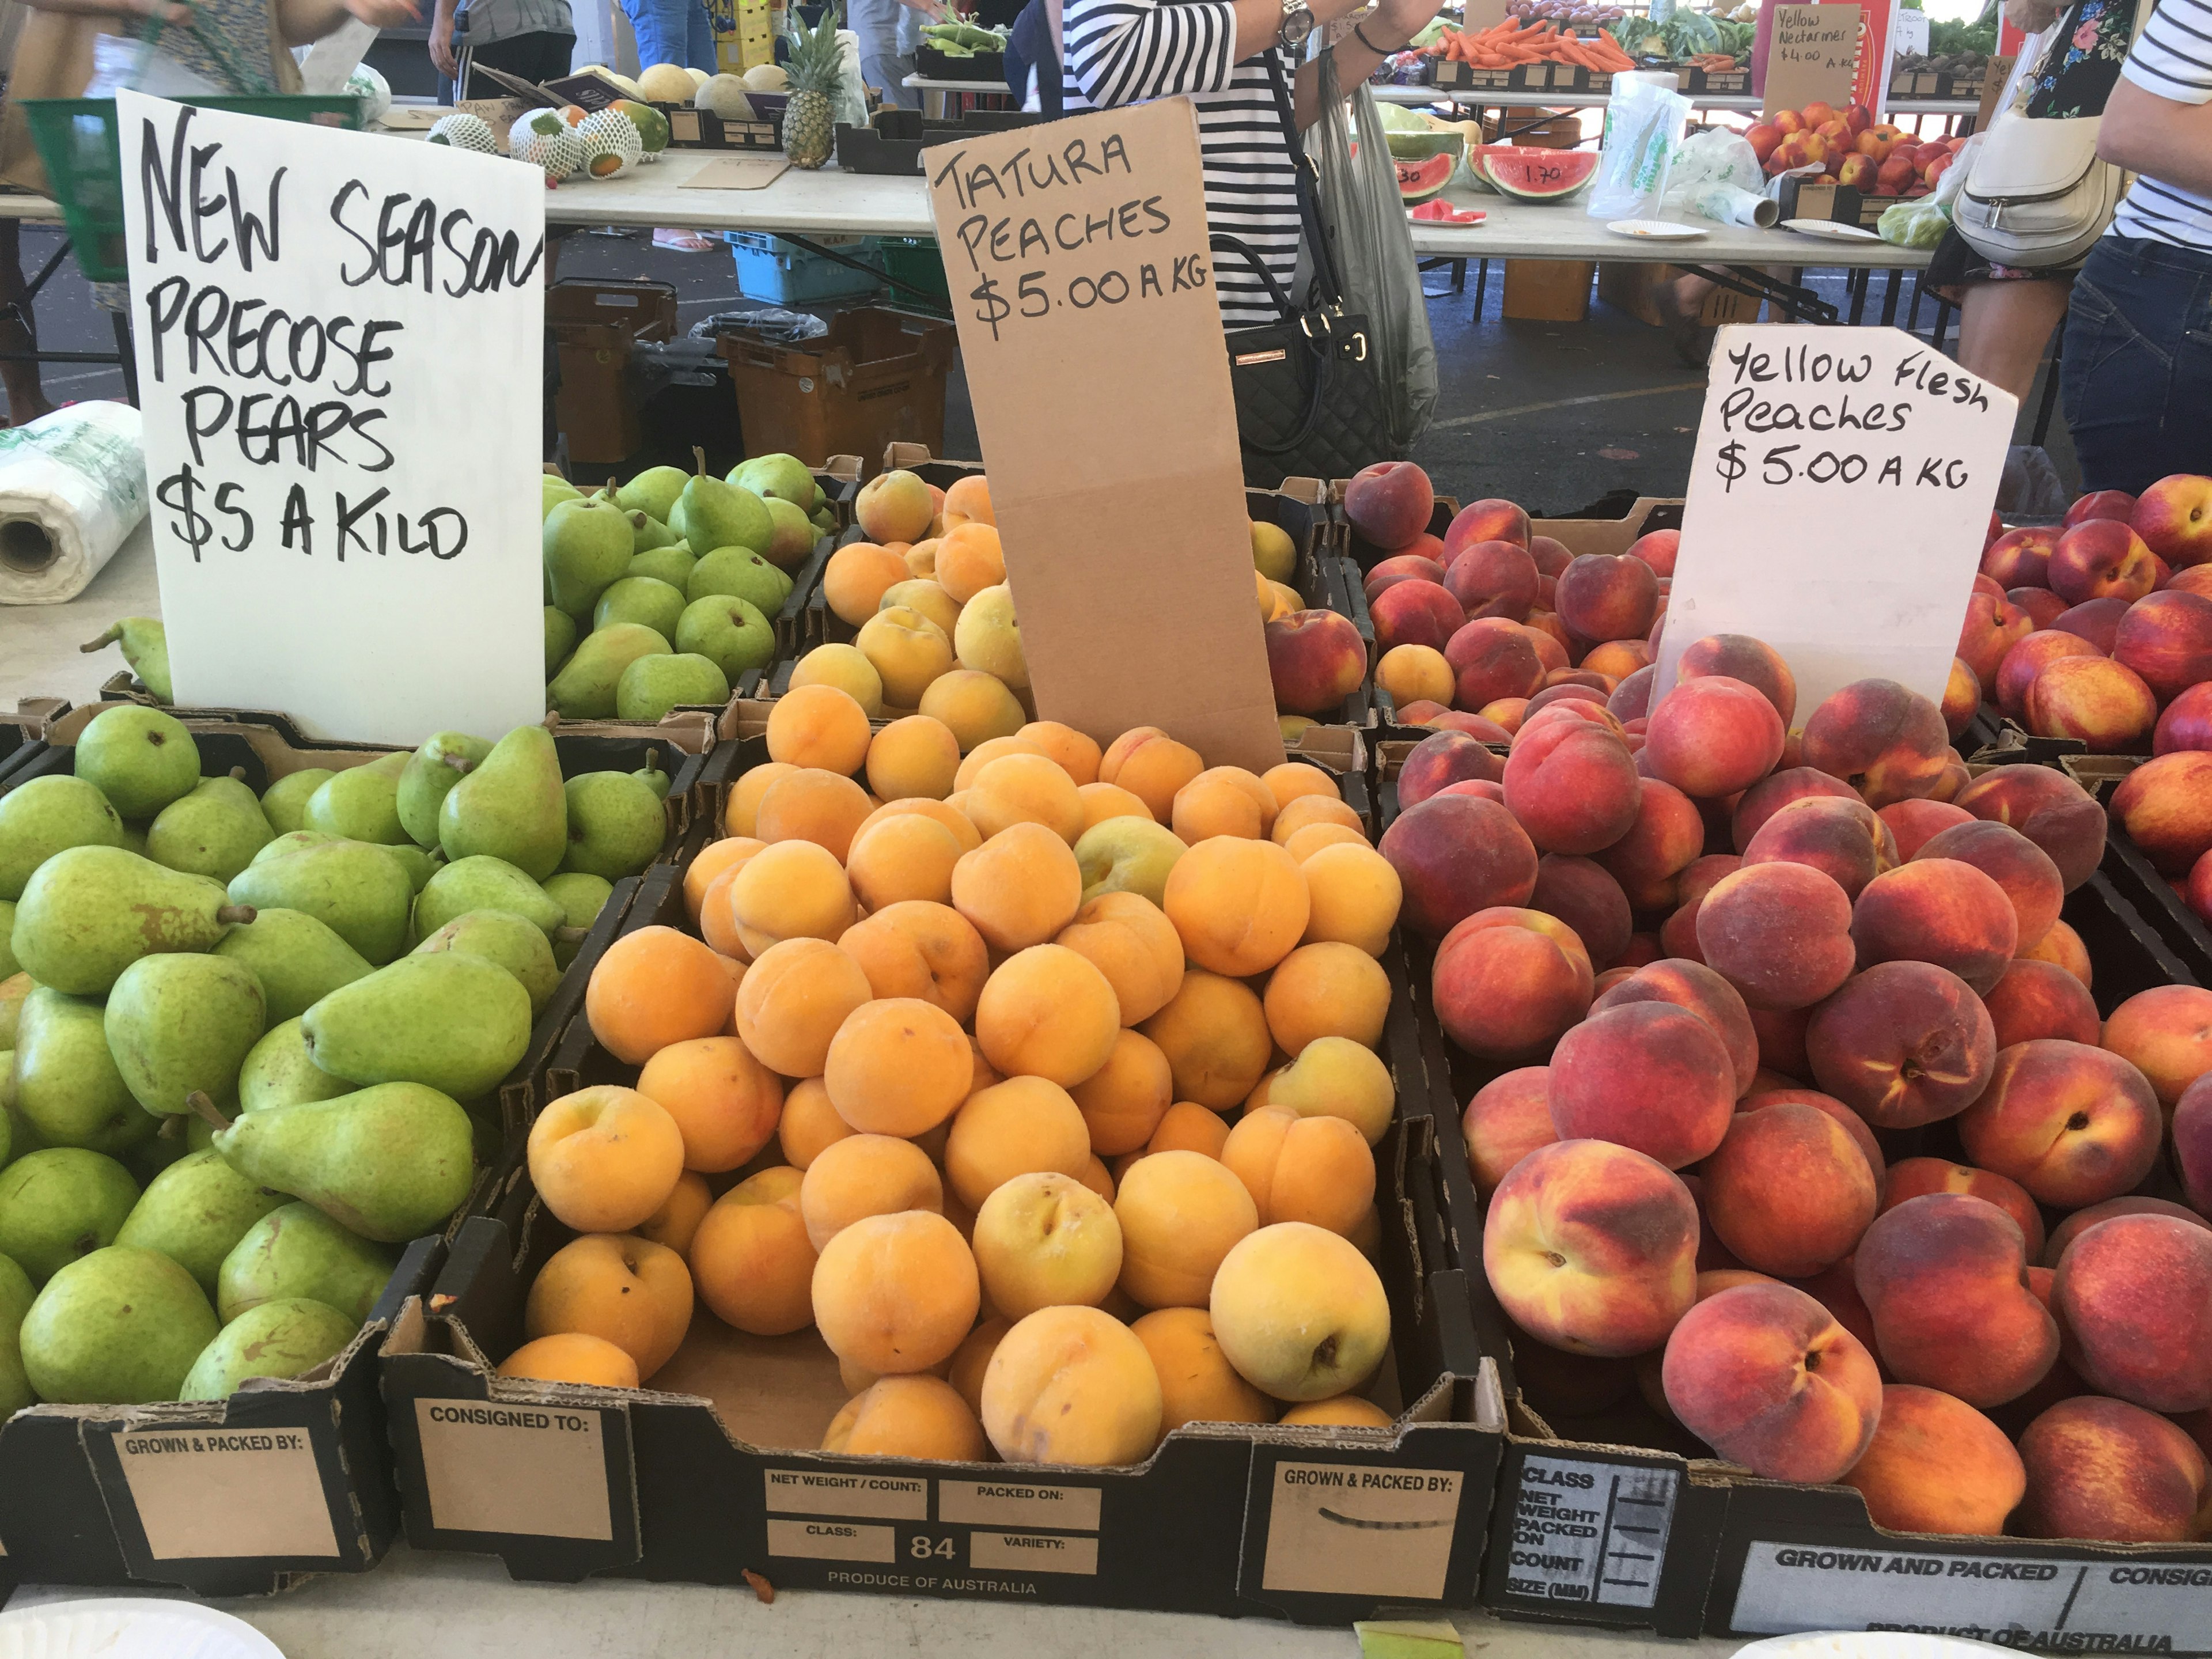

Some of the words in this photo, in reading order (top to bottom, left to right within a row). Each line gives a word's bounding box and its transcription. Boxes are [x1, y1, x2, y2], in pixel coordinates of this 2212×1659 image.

[1779, 9, 1820, 28] Yellow
[1782, 47, 1820, 62] $4.00
[1826, 58, 1836, 69] A
[461, 101, 495, 118] PAW
[934, 134, 1131, 209] TATURA
[1526, 165, 1560, 184] 1.70
[142, 106, 287, 271] NEW
[957, 195, 1171, 271] PEACHES
[971, 270, 1129, 341] $5.00
[1141, 264, 1162, 298] A
[1172, 253, 1207, 293] KG
[146, 275, 403, 397] PRECOSE
[1728, 343, 1872, 385] Yellow
[1895, 350, 1988, 412] Flesh
[1721, 388, 1912, 433] Peaches
[181, 385, 395, 472] PEARS
[1878, 456, 1902, 486] A
[1916, 457, 1968, 489] KG
[156, 464, 253, 562] $5
[281, 484, 312, 555] A
[338, 487, 468, 562] KILO
[430, 1407, 550, 1430] CONSIGNED
[554, 1415, 589, 1432] TO:
[125, 1437, 190, 1455] GROWN
[192, 1437, 205, 1452] &
[209, 1435, 272, 1452] PACKED
[276, 1435, 304, 1450] BY:
[771, 1474, 800, 1486] NET
[802, 1475, 858, 1489] WEIGHT
[869, 1480, 922, 1493] COUNT:
[1284, 1469, 1343, 1487] GROWN
[1346, 1472, 1358, 1488] &
[1362, 1473, 1424, 1490] PACKED
[1427, 1476, 1453, 1493] BY:
[1522, 1467, 1594, 1489] CLASS
[978, 1486, 1035, 1499] PACKED
[1038, 1488, 1064, 1501] ON:
[1518, 1490, 1562, 1506] NET
[1517, 1503, 1600, 1523] WEIGHT
[806, 1525, 857, 1537] CLASS:
[1513, 1531, 1544, 1546] ON
[1515, 1518, 1597, 1538] PACKED
[910, 1535, 956, 1560] 84
[1004, 1536, 1066, 1550] VARIETY:
[1511, 1551, 1584, 1571] COUNT
[1775, 1549, 1883, 1573] GROWN
[1883, 1557, 1944, 1576] AND
[1947, 1560, 2058, 1581] PACKED
[828, 1571, 910, 1588] PRODUCE
[915, 1577, 938, 1589] OF
[943, 1578, 1036, 1594] AUSTRALIA
[2109, 1567, 2212, 1586] CONSIG
[1508, 1577, 1546, 1595] SIZE
[1548, 1582, 1590, 1601] (MM)
[2029, 1630, 2172, 1653] AUSTRALIA
